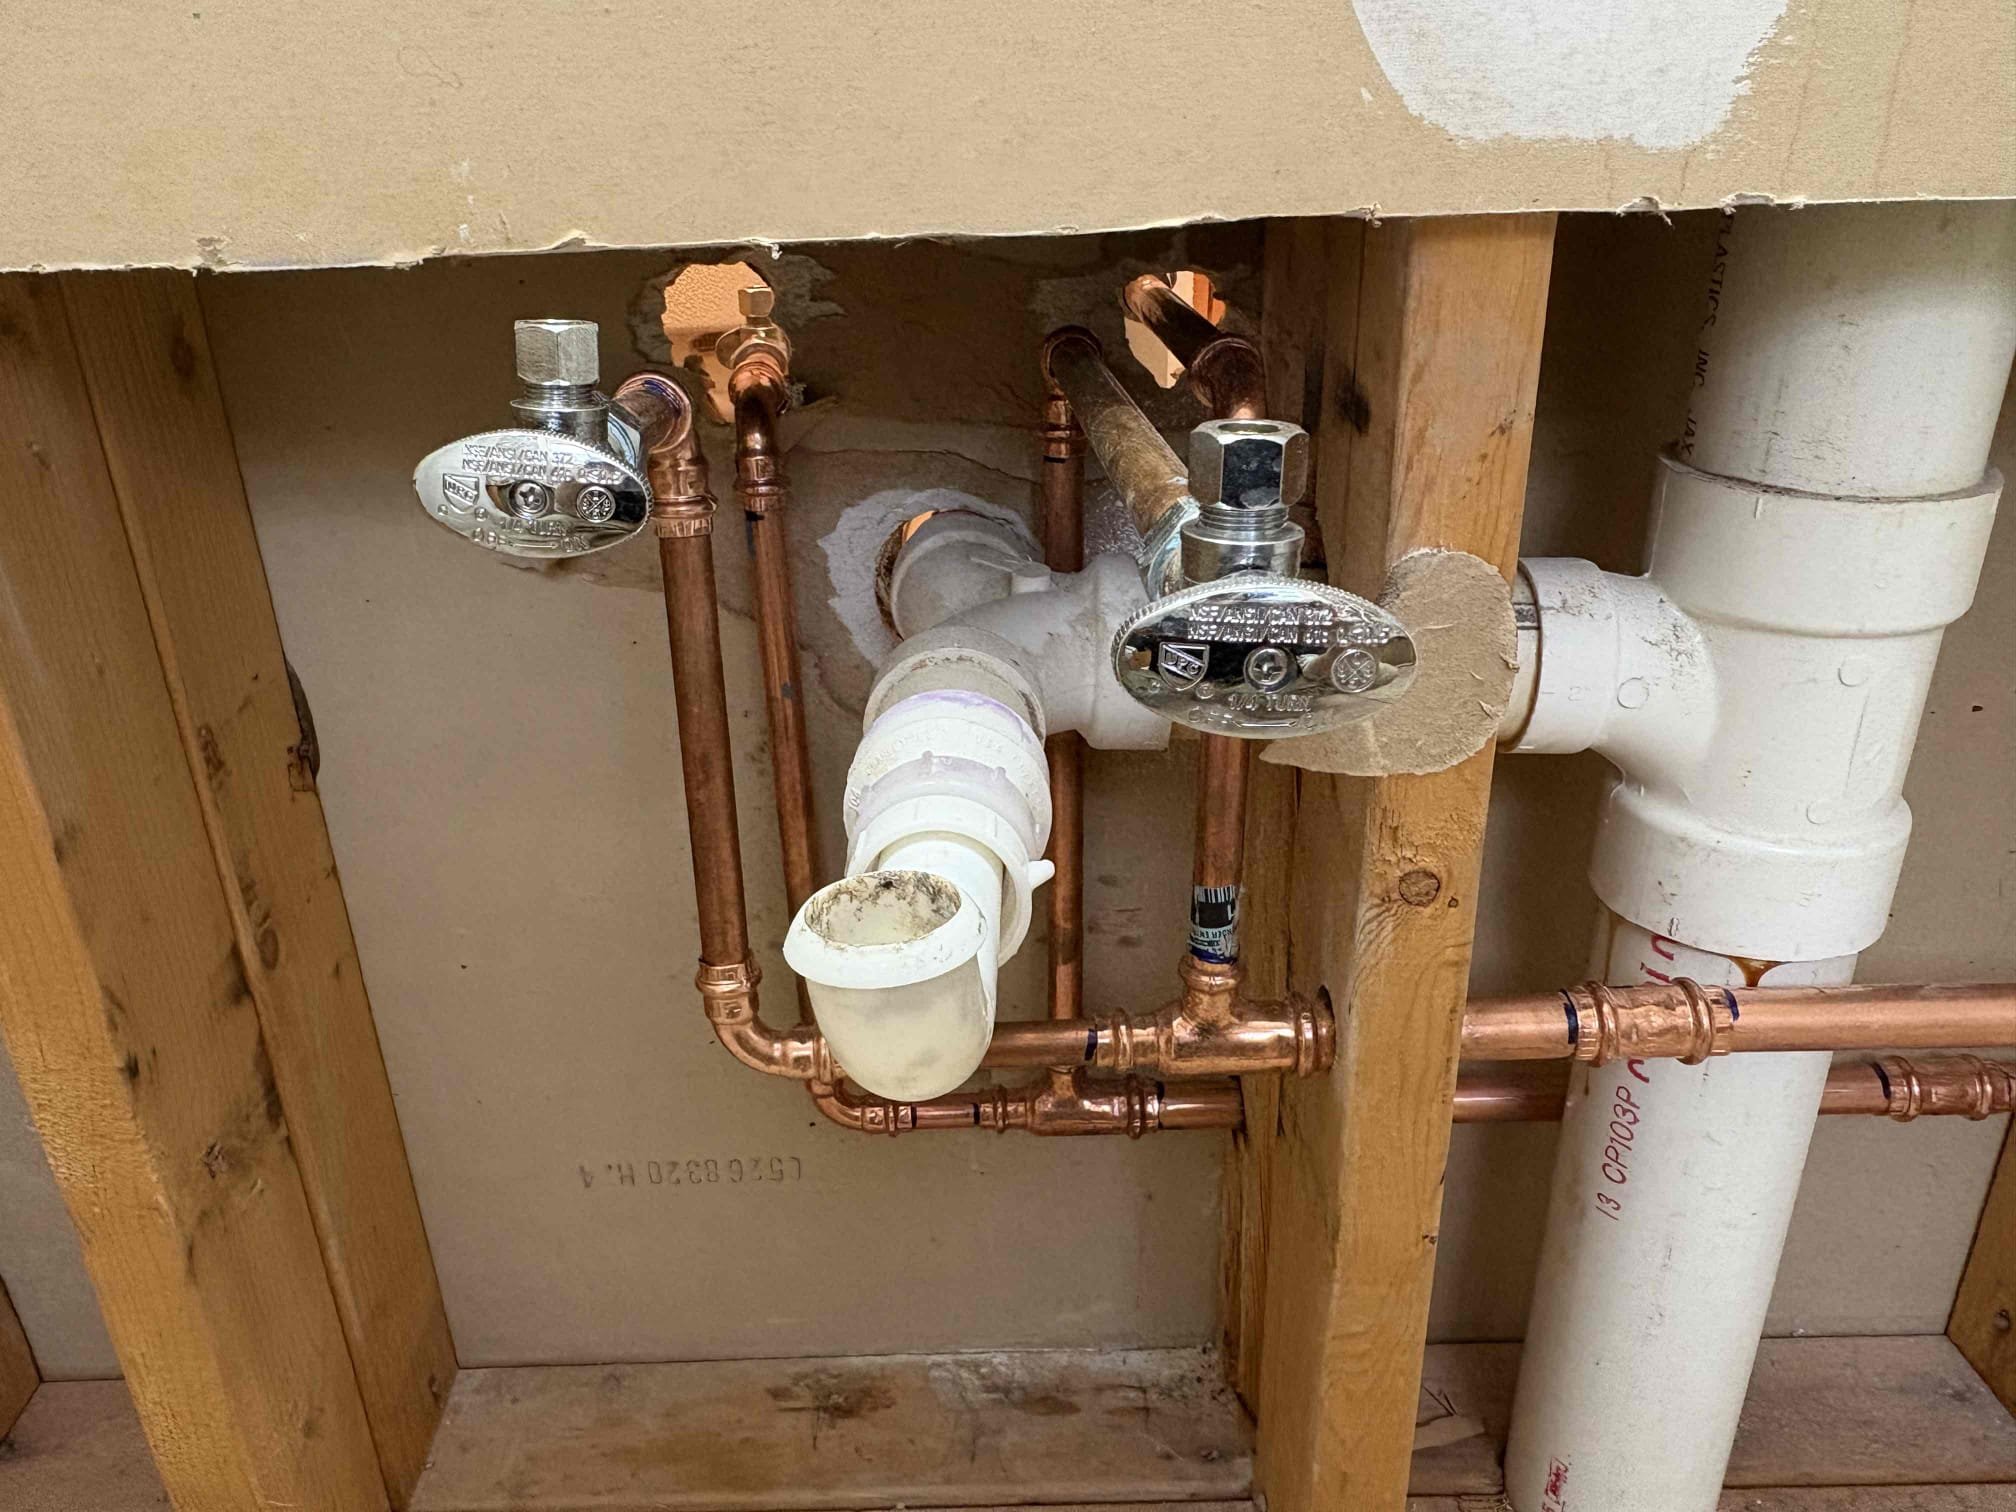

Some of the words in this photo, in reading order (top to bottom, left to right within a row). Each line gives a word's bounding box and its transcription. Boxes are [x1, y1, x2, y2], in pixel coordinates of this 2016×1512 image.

[1164, 650, 1200, 677] UPC
[1600, 1085, 1641, 1185] CP103P
[1595, 1191, 1622, 1222] 13
